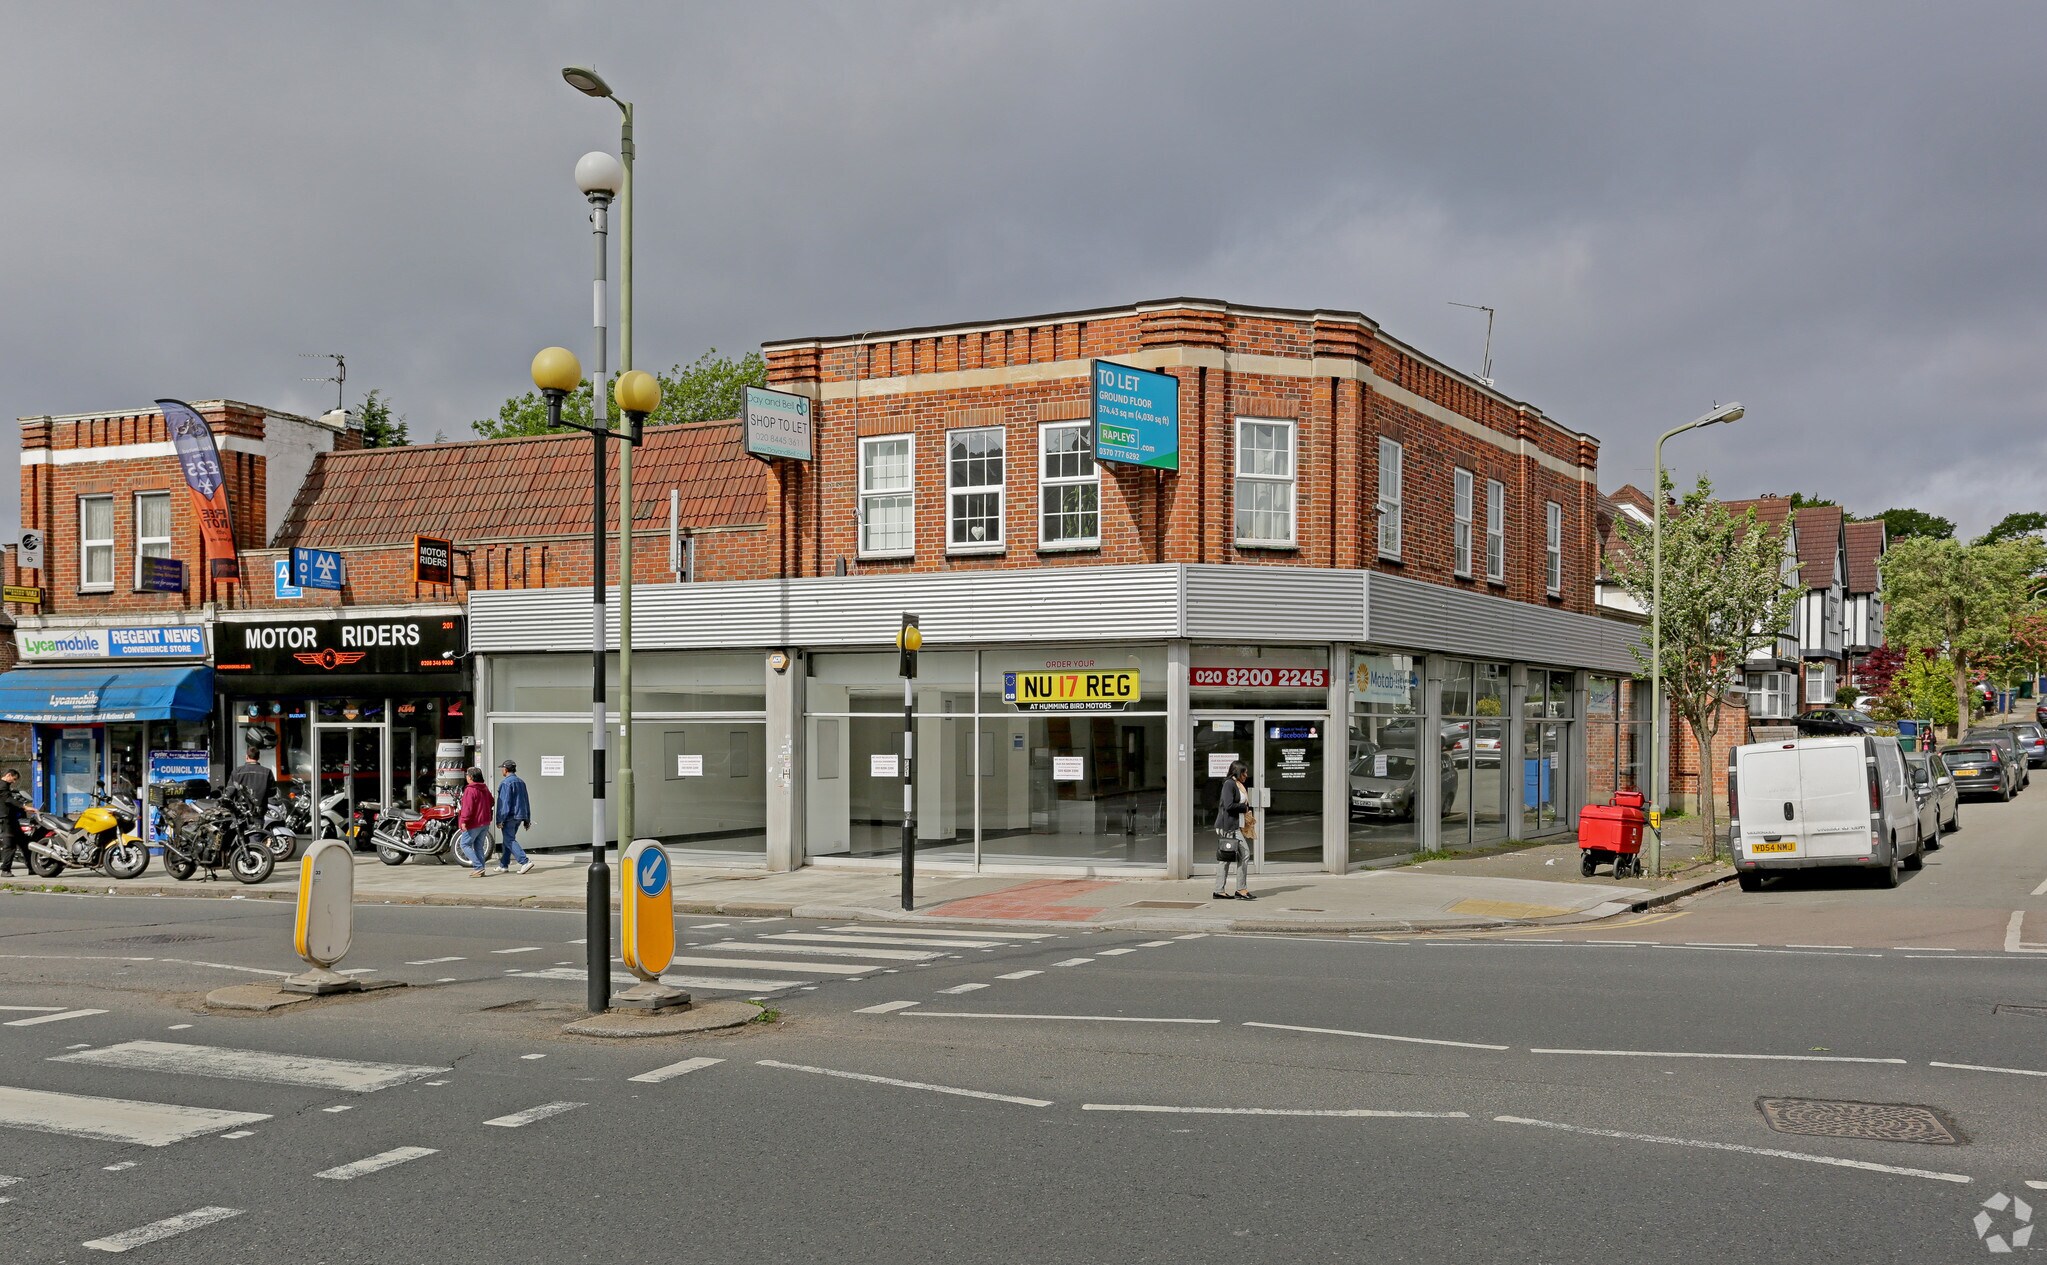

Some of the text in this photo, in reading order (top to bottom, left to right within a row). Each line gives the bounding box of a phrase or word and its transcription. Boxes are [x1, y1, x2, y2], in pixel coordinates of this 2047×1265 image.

[1099, 369, 1139, 391] TO LET
[747, 393, 763, 405] Day
[764, 398, 780, 407] and
[783, 400, 794, 410] Bell
[1099, 391, 1152, 408] GROUND FLOOR
[1099, 405, 1118, 416] 374.43
[1119, 410, 1127, 419] sq
[1154, 417, 1162, 425] sq
[750, 414, 807, 434] SHOP TO LET
[755, 433, 769, 442] 020
[771, 434, 787, 445] 8445
[1102, 429, 1136, 443] RAPLEYS
[1099, 447, 1140, 460] 0370 777 6292
[420, 546, 447, 558] MOTOR
[420, 556, 447, 567] RIDERS
[111, 629, 200, 644] REGENT NEWS
[245, 623, 420, 649] MOTOR RIDERS
[25, 636, 99, 654] Lycamobile
[169, 645, 191, 653] STORE
[1196, 669, 1324, 686] 020 8200 2245
[1024, 674, 1130, 698] NU 17 REG
[50, 694, 98, 707] Lycamobile
[398, 704, 415, 713] KTM
[160, 765, 208, 774] COUNCIL TAX
[1755, 843, 1793, 852] YD54 NMJ
